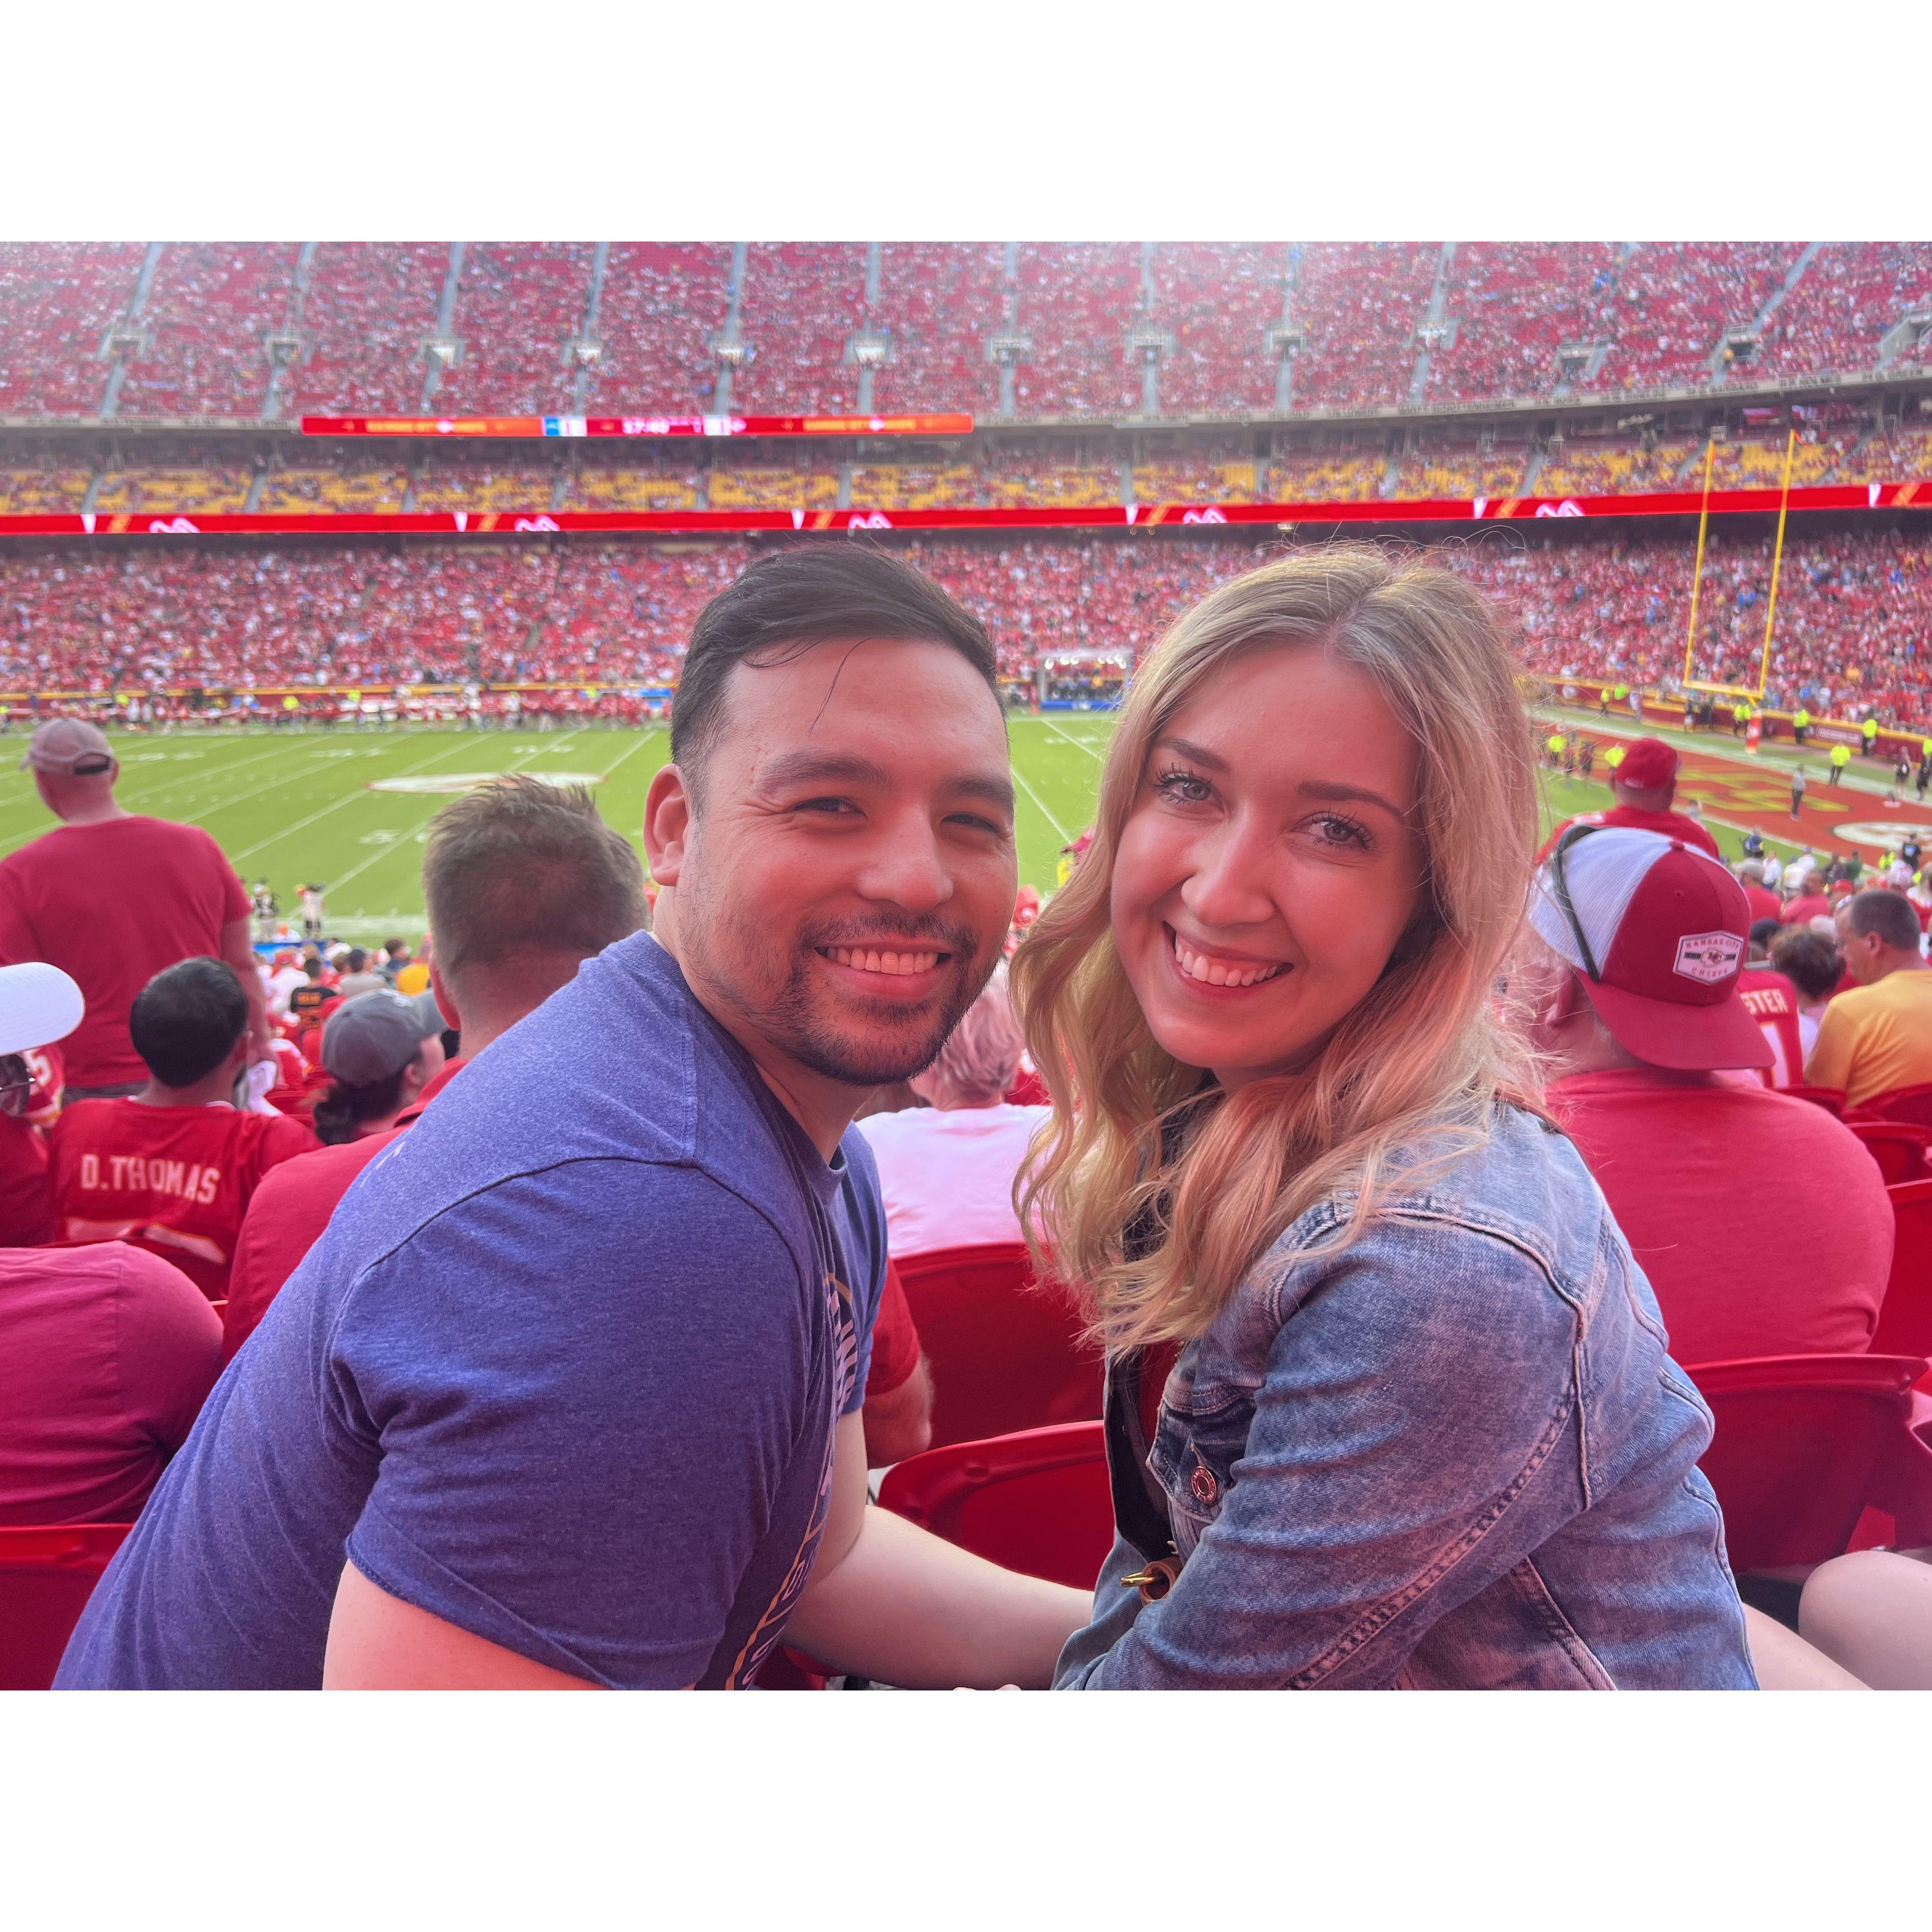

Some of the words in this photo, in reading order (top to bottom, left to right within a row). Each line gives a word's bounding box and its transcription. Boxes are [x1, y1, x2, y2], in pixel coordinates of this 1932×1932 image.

[1686, 937, 1724, 948] KANSAS
[1725, 940, 1739, 949] CITY
[1691, 967, 1727, 977] CHIEFS
[80, 1153, 220, 1204] D.THOMAS
